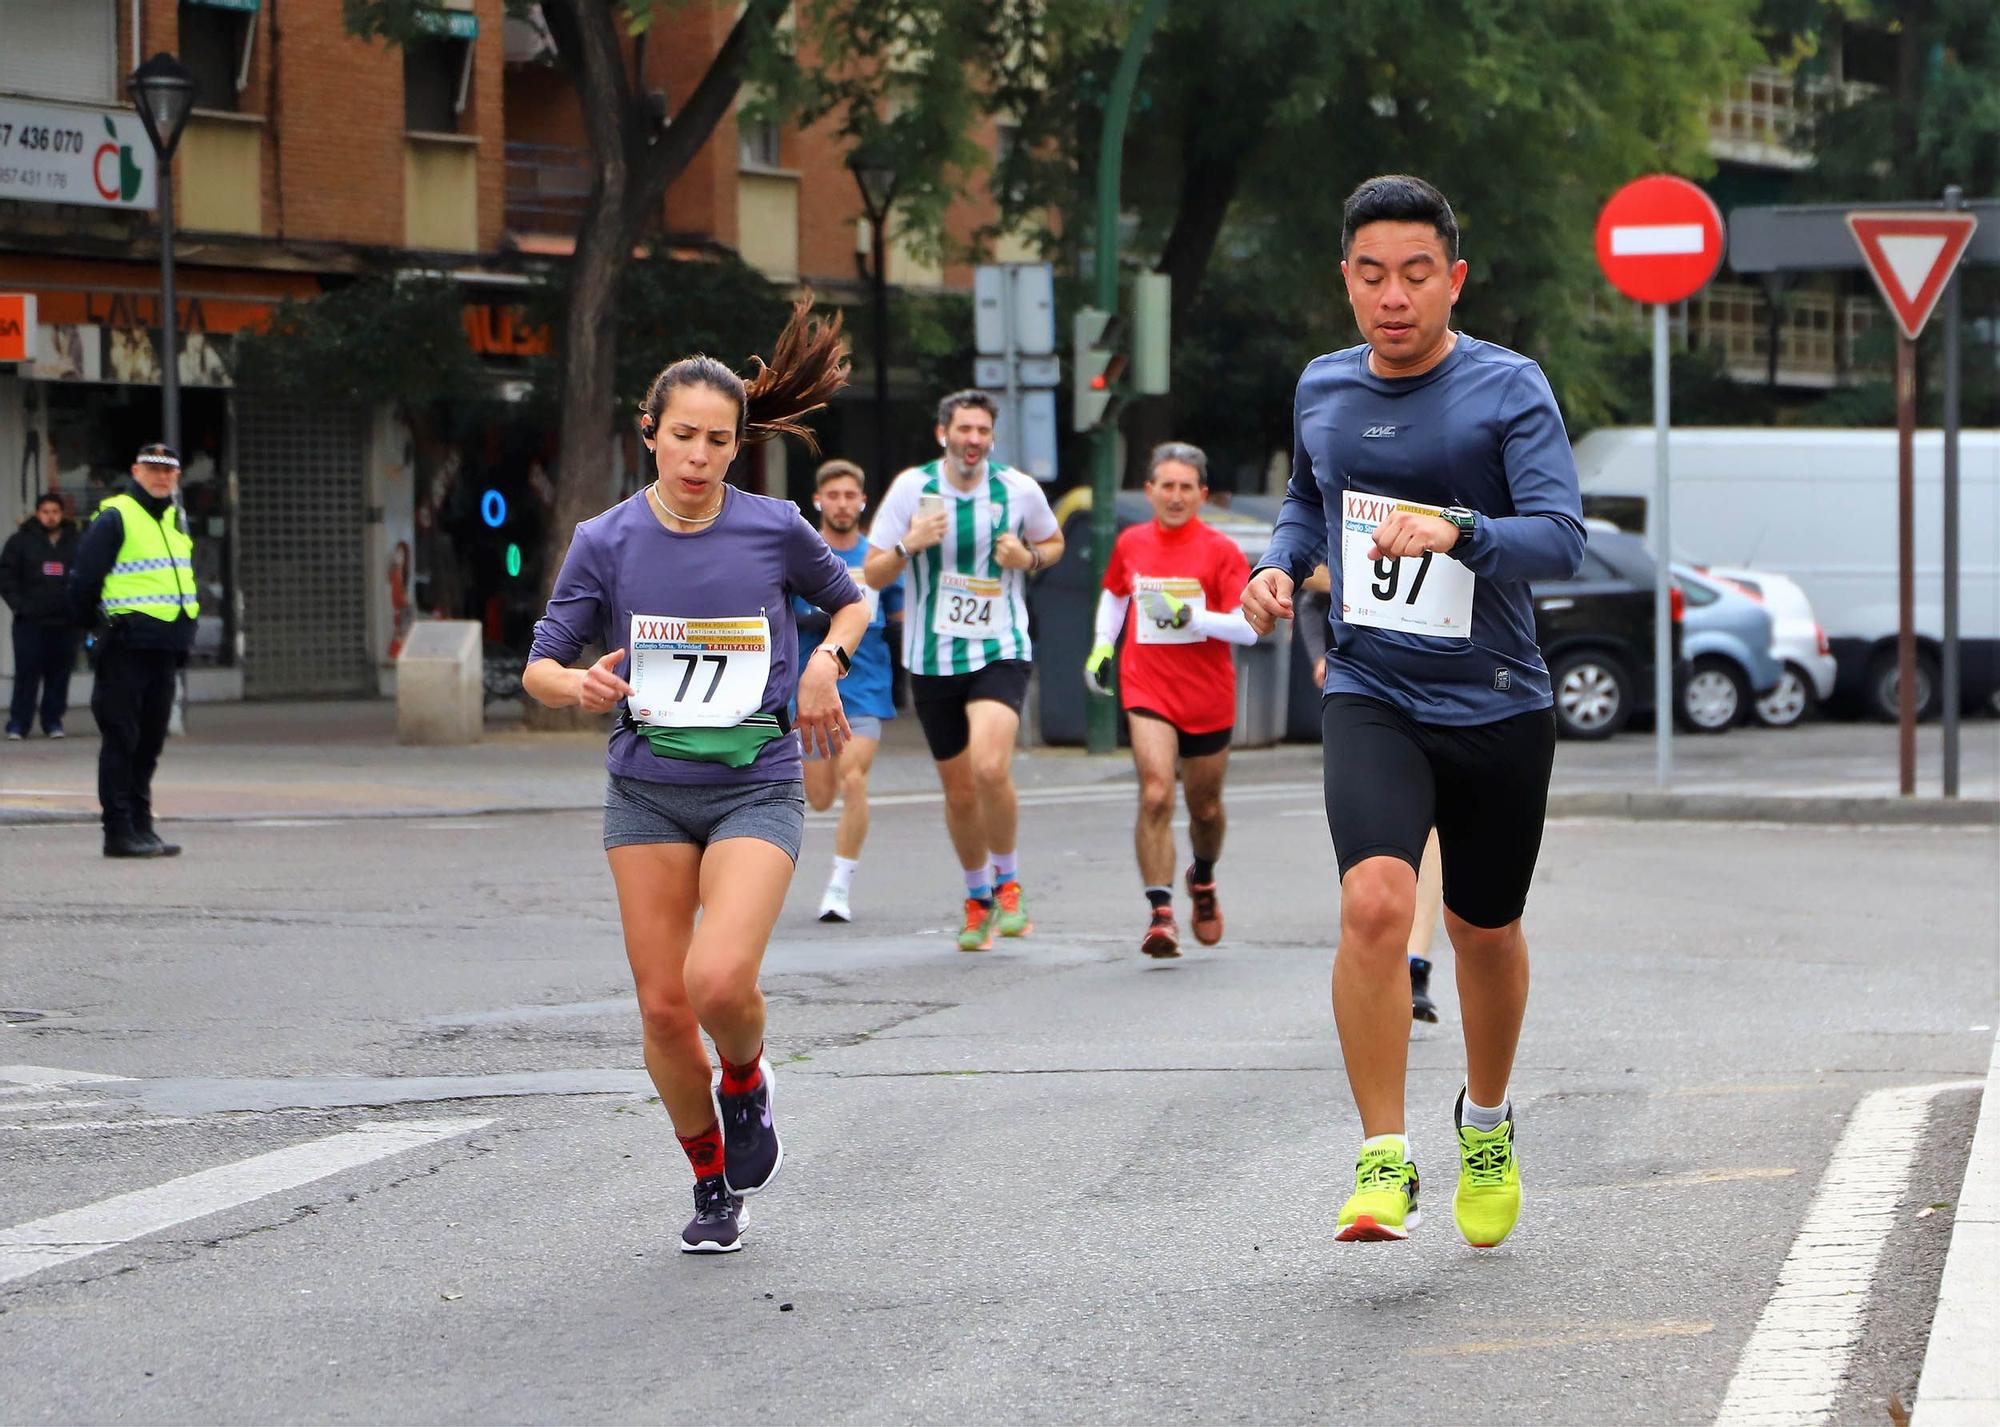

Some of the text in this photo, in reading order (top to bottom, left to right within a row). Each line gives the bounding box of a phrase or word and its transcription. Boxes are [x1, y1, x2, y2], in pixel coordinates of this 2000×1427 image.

[0, 124, 84, 154] 7 436 070
[1372, 550, 1433, 605] 97
[949, 595, 992, 626] 324
[637, 620, 687, 640] XXXIX
[635, 642, 658, 650] Colegio
[708, 643, 765, 652] TRINITARIOS
[673, 654, 728, 703] 77
